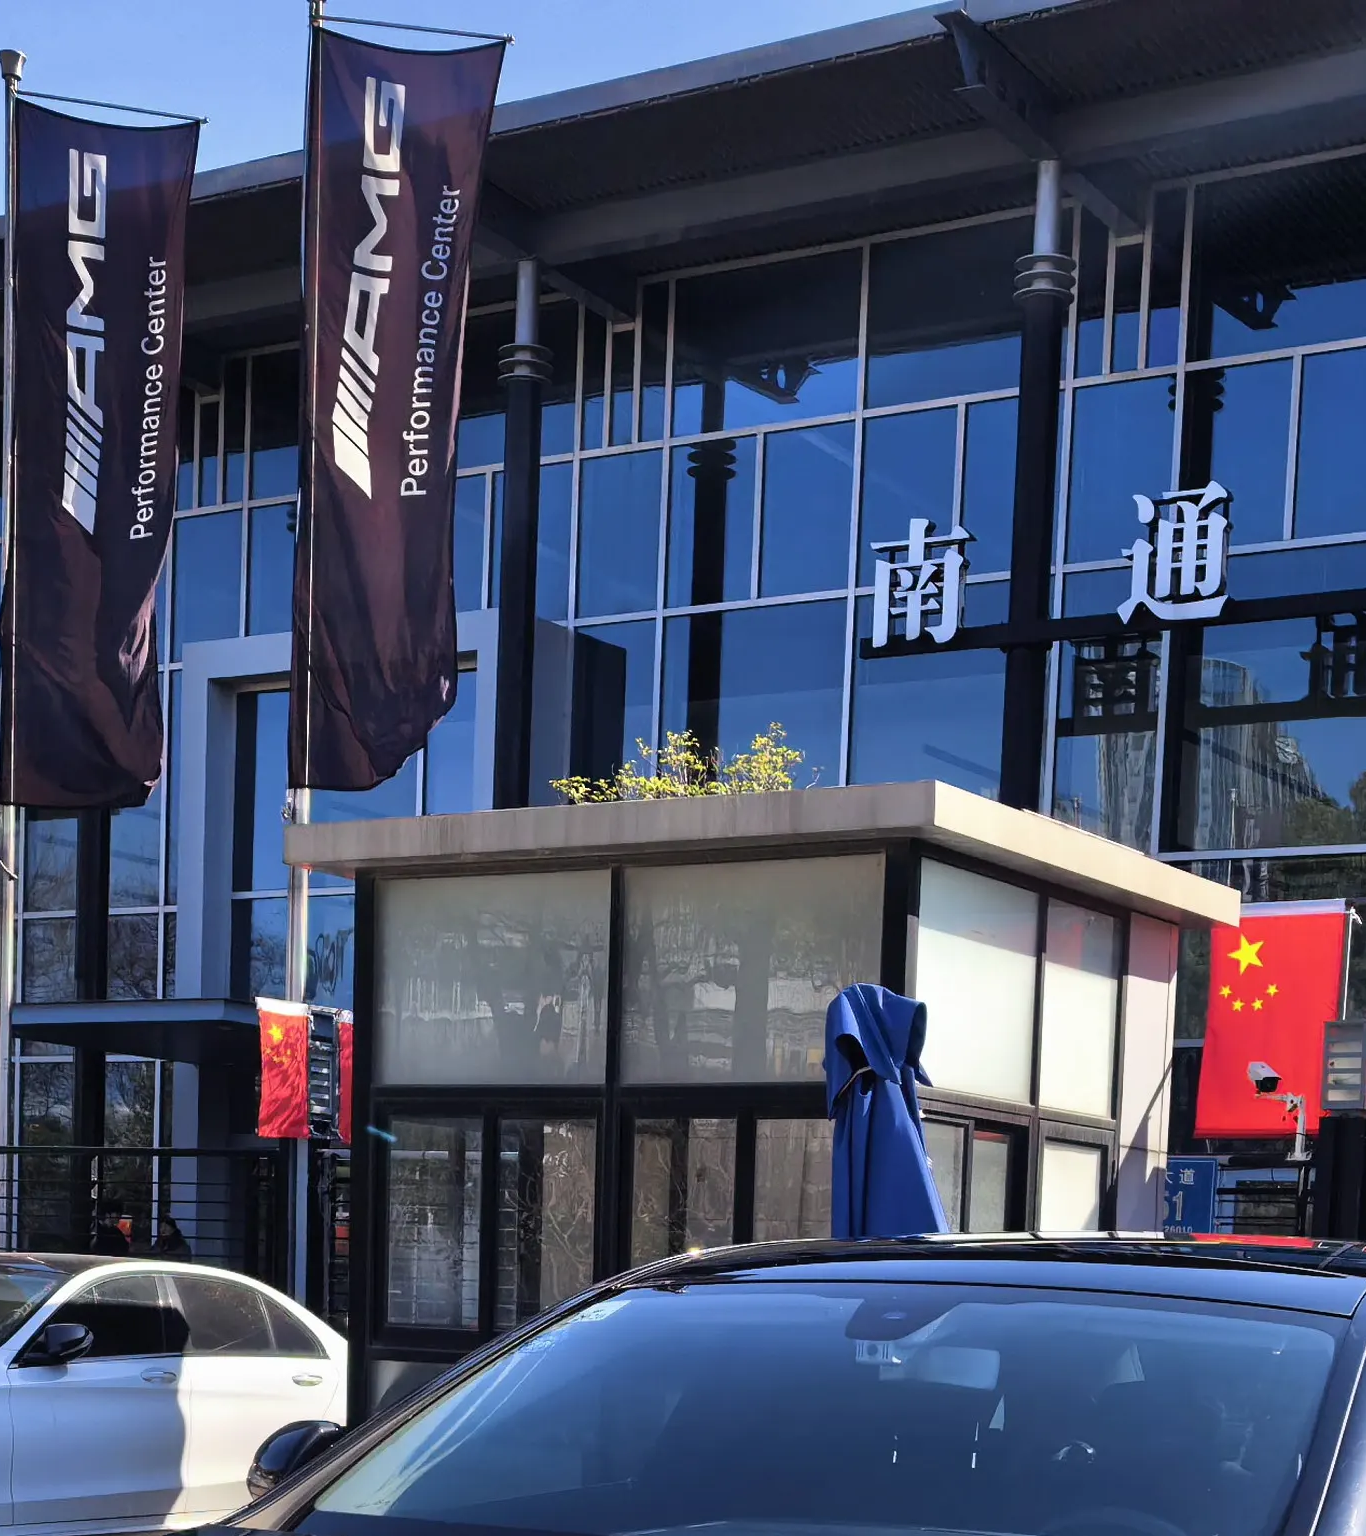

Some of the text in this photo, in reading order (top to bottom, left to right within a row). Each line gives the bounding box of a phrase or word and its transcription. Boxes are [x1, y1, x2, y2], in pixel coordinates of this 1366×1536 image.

[66, 148, 108, 429] AMG
[343, 76, 406, 376] AMG
[401, 185, 461, 497] Performance Center
[129, 256, 168, 540] Performance Center
